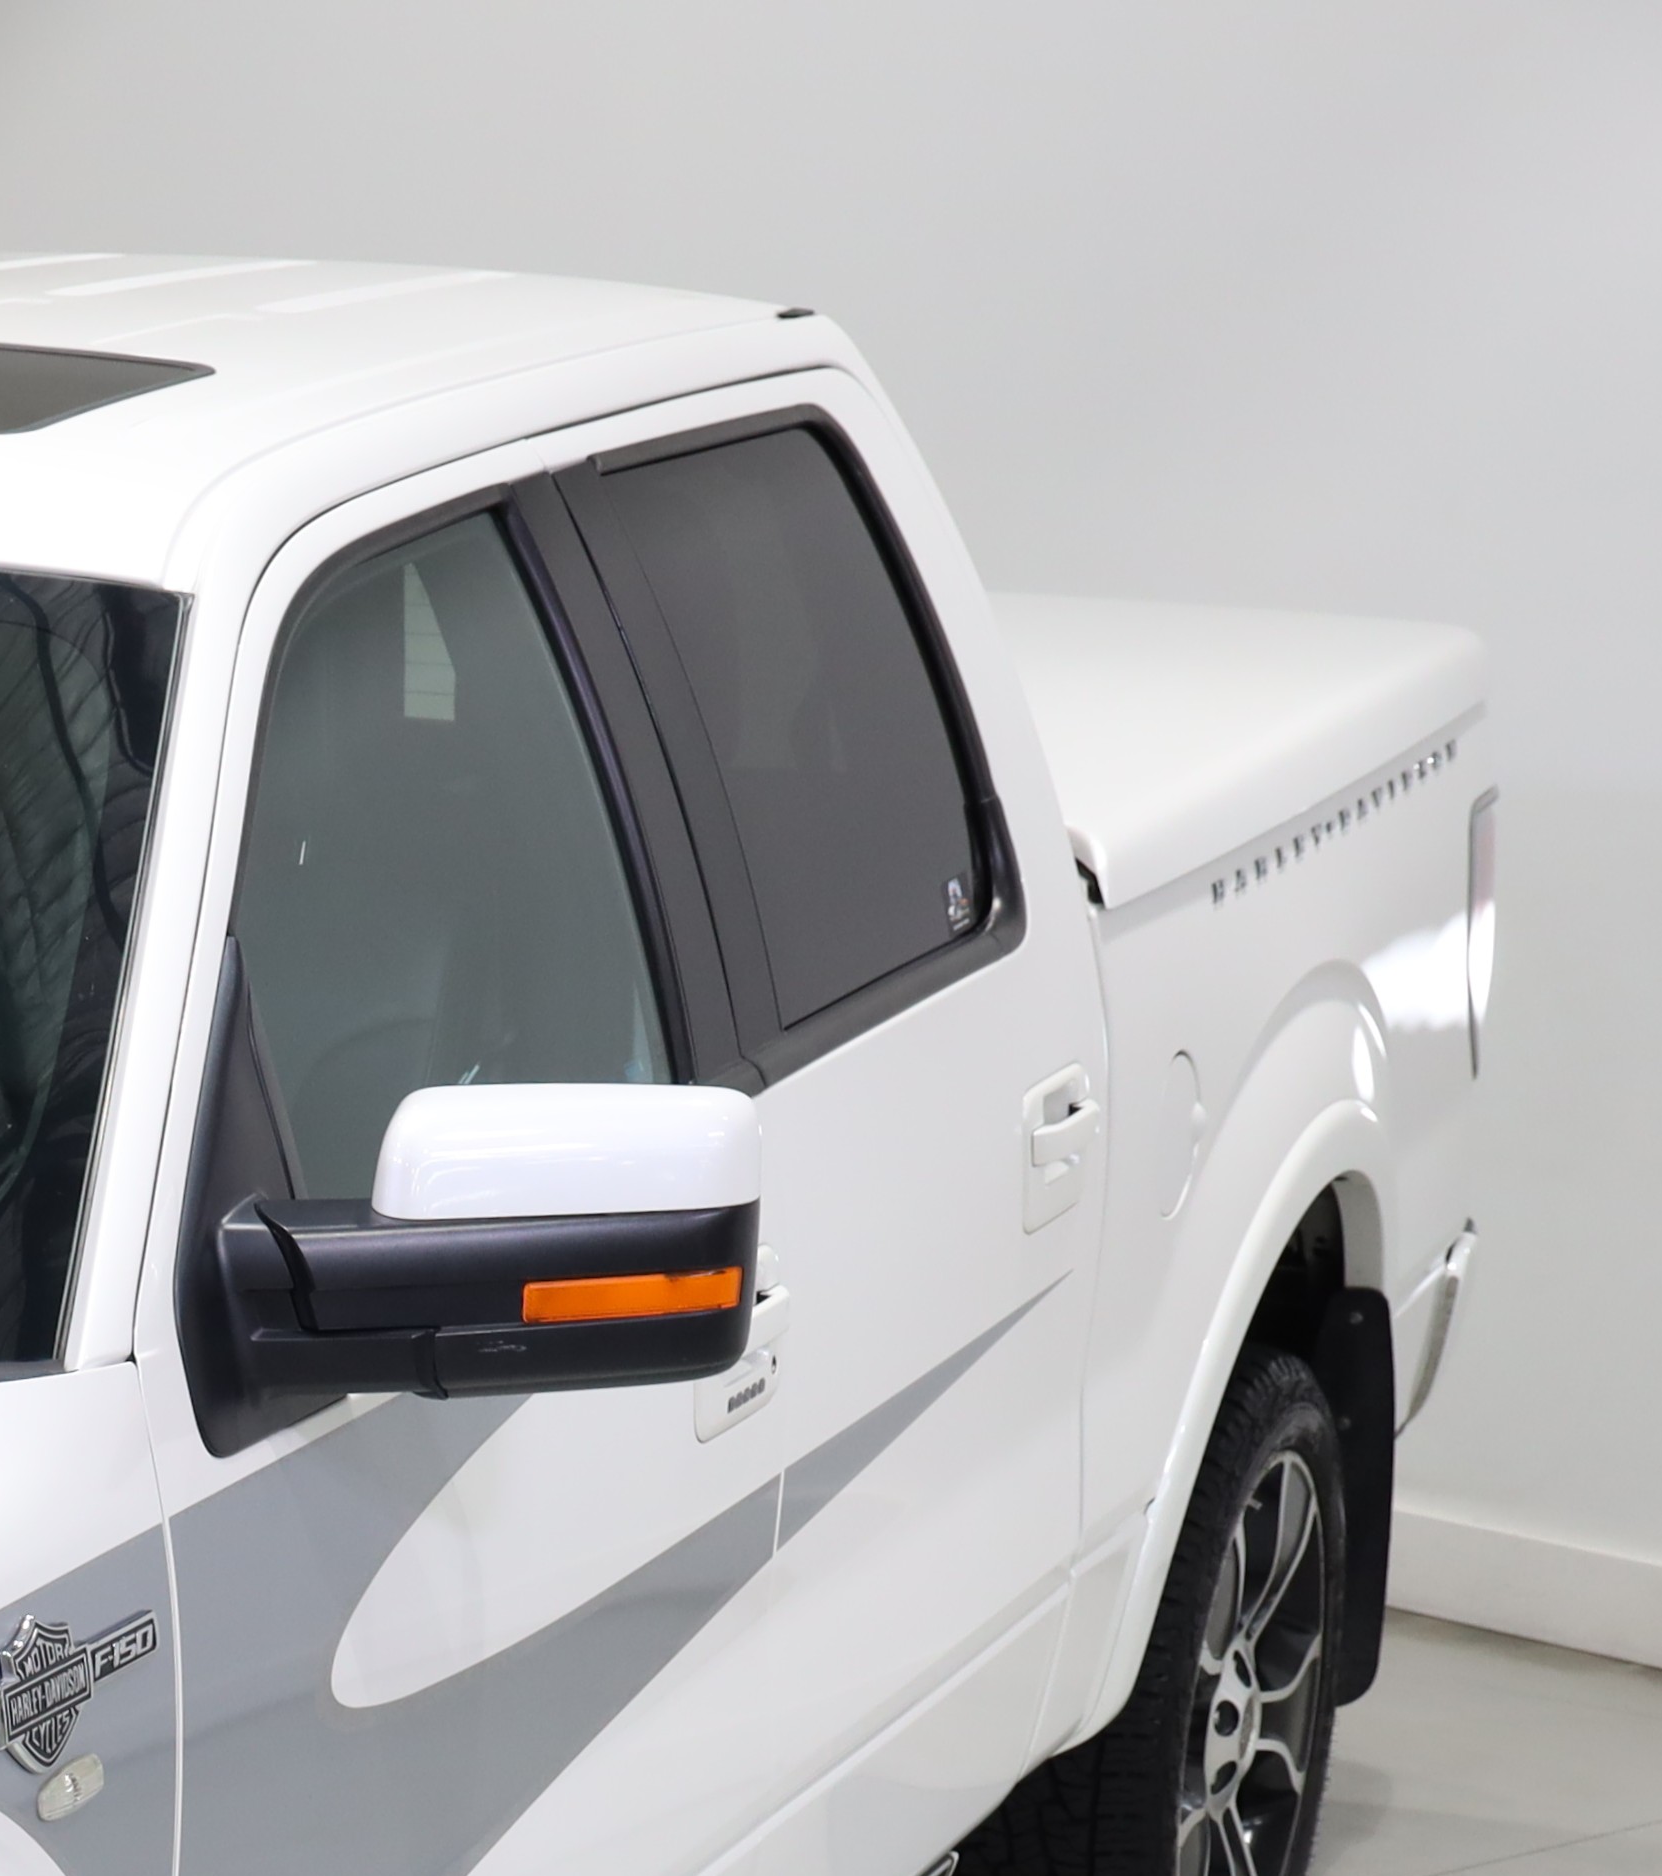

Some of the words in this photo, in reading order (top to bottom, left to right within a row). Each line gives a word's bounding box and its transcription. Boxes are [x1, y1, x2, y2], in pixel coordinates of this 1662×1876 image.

[24, 1635, 65, 1677] MOTOR
[94, 1623, 154, 1677] F-150
[10, 1661, 86, 1727] HARLEY-DAVIDSON
[31, 1709, 70, 1754] CYCLES
